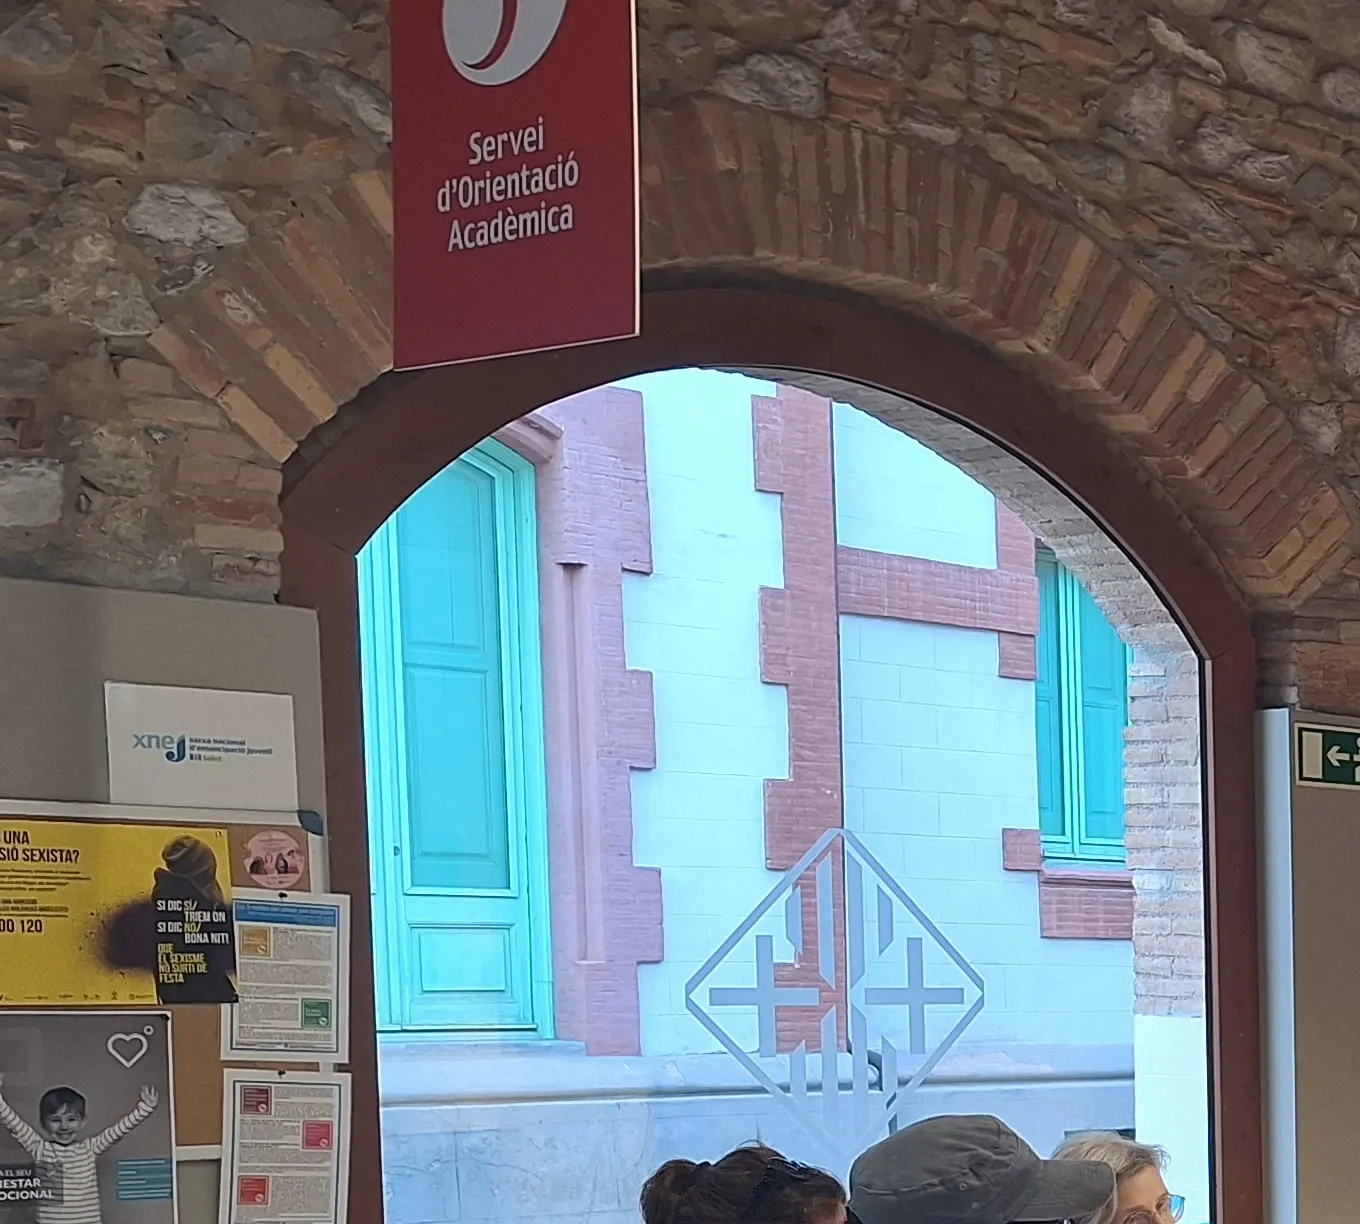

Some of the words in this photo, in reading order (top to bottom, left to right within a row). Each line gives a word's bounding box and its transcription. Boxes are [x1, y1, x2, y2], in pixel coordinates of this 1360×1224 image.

[468, 115, 544, 165] Servei
[437, 151, 579, 213] d'Orientació
[448, 200, 573, 252] Acadèmica
[3, 830, 30, 845] UNA
[22, 848, 80, 864] SEXISTA?
[167, 899, 183, 911] DIC
[212, 911, 226, 922] ON
[20, 919, 43, 934] 120
[167, 922, 183, 933] DIC
[184, 932, 210, 944] BONA
[169, 952, 205, 963] SEXISME
[159, 973, 185, 984] FESTA
